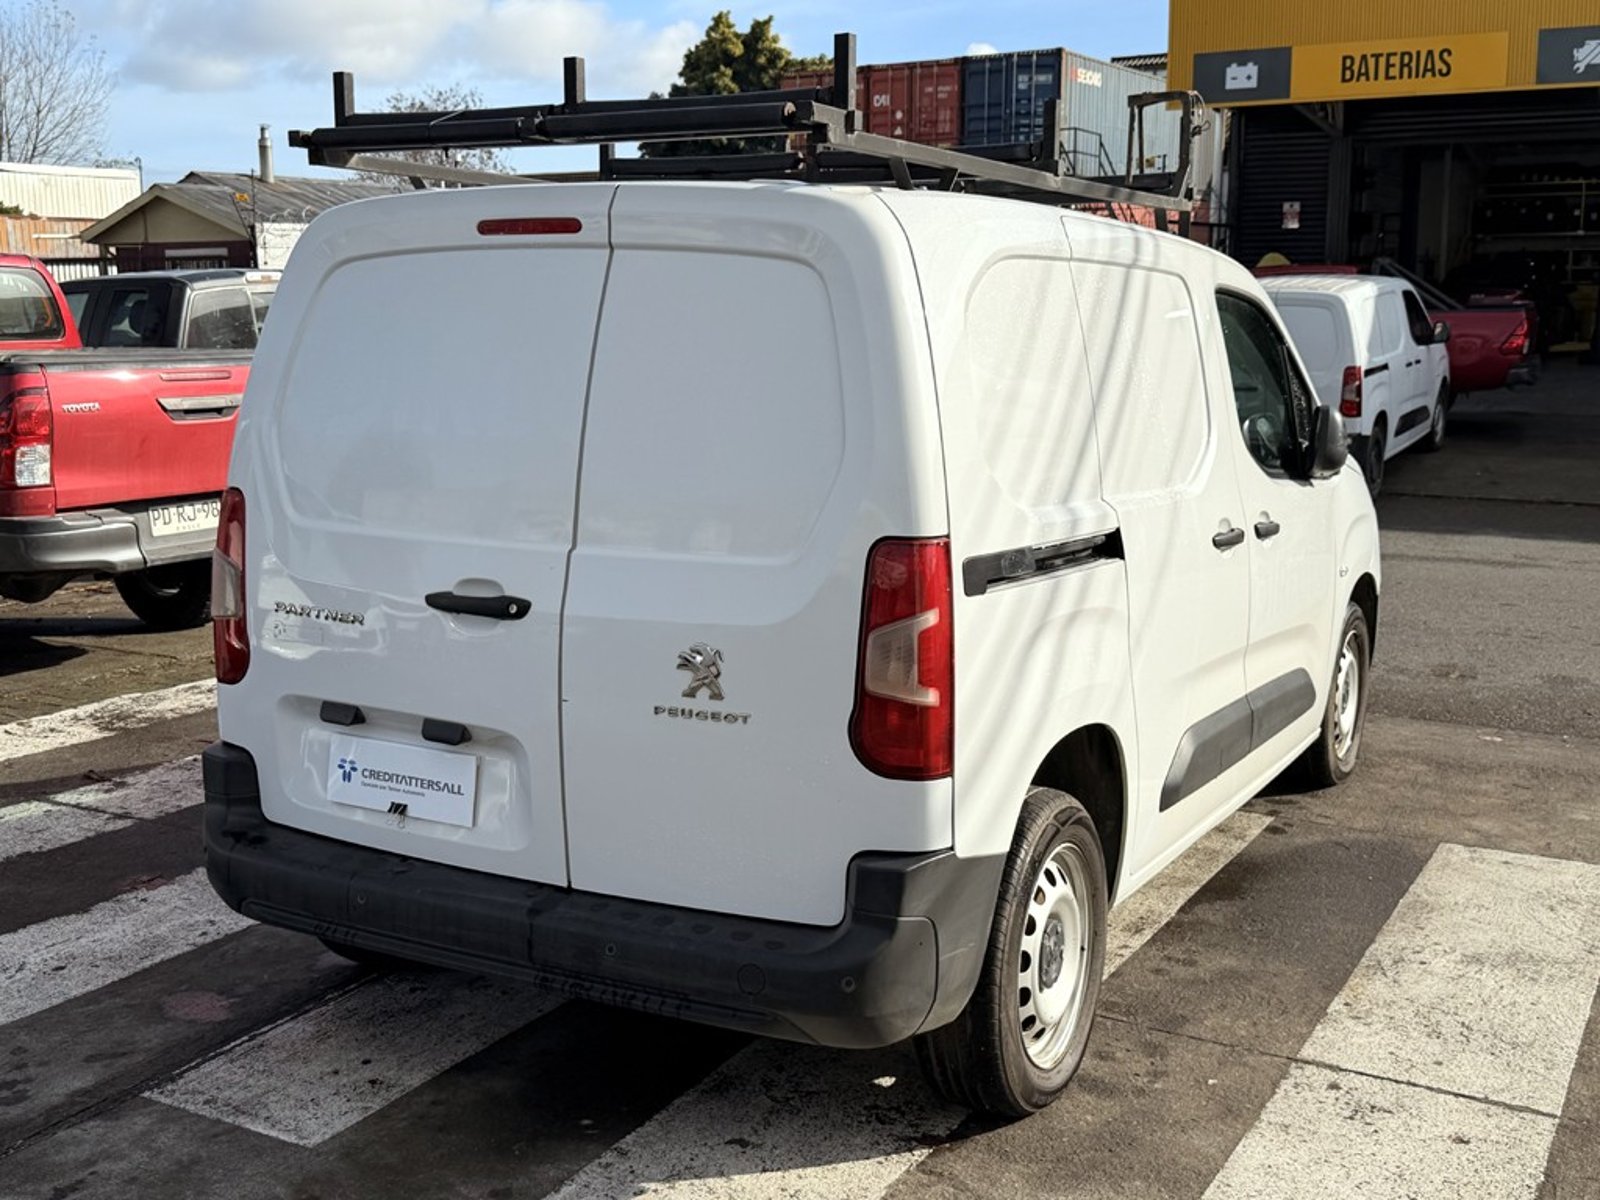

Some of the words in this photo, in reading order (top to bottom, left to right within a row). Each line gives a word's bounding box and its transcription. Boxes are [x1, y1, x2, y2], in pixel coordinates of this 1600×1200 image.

[1340, 48, 1453, 83] BATERIAS
[61, 402, 101, 413] TOYOTA
[274, 601, 365, 626] PARTNER
[653, 705, 752, 725] PEUGEOT
[361, 768, 465, 796] CREDITATTERSALL
